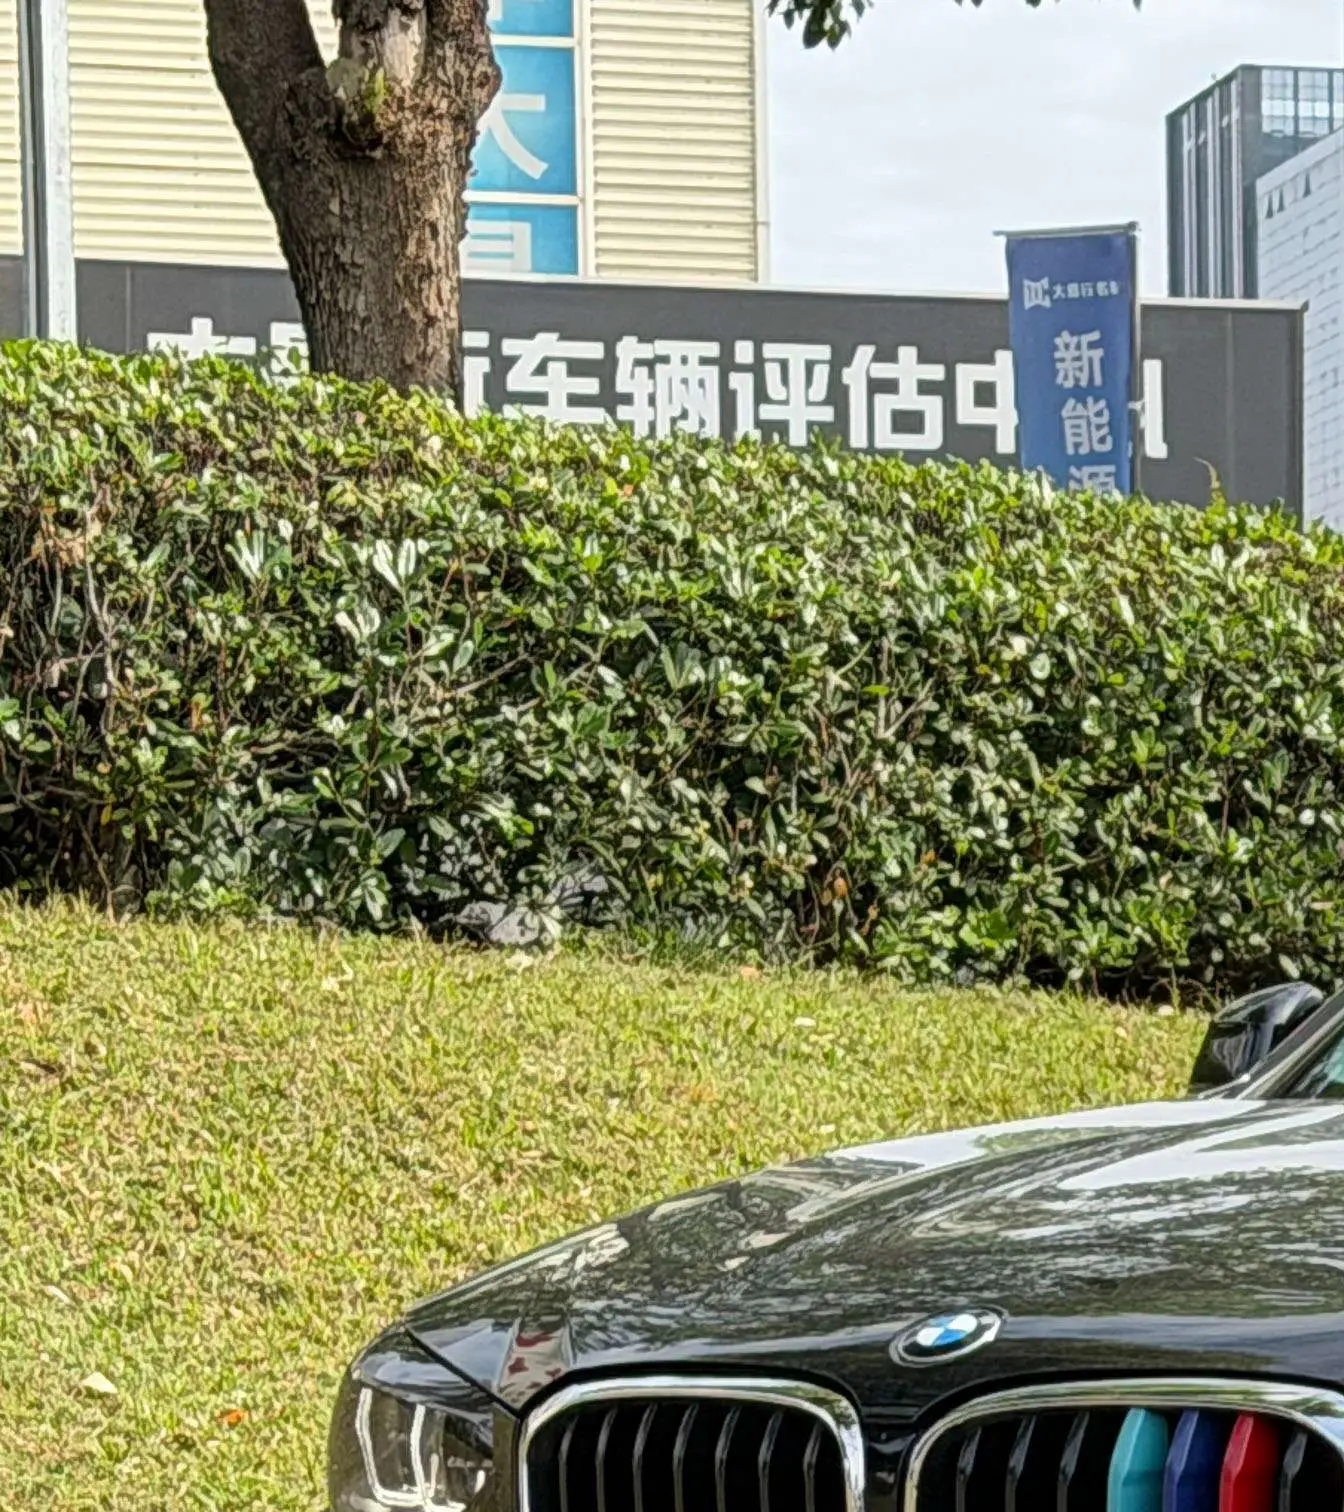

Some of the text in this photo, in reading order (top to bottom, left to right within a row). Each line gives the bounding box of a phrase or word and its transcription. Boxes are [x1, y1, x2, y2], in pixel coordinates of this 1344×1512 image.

[147, 316, 1168, 459] 车辆评估中
